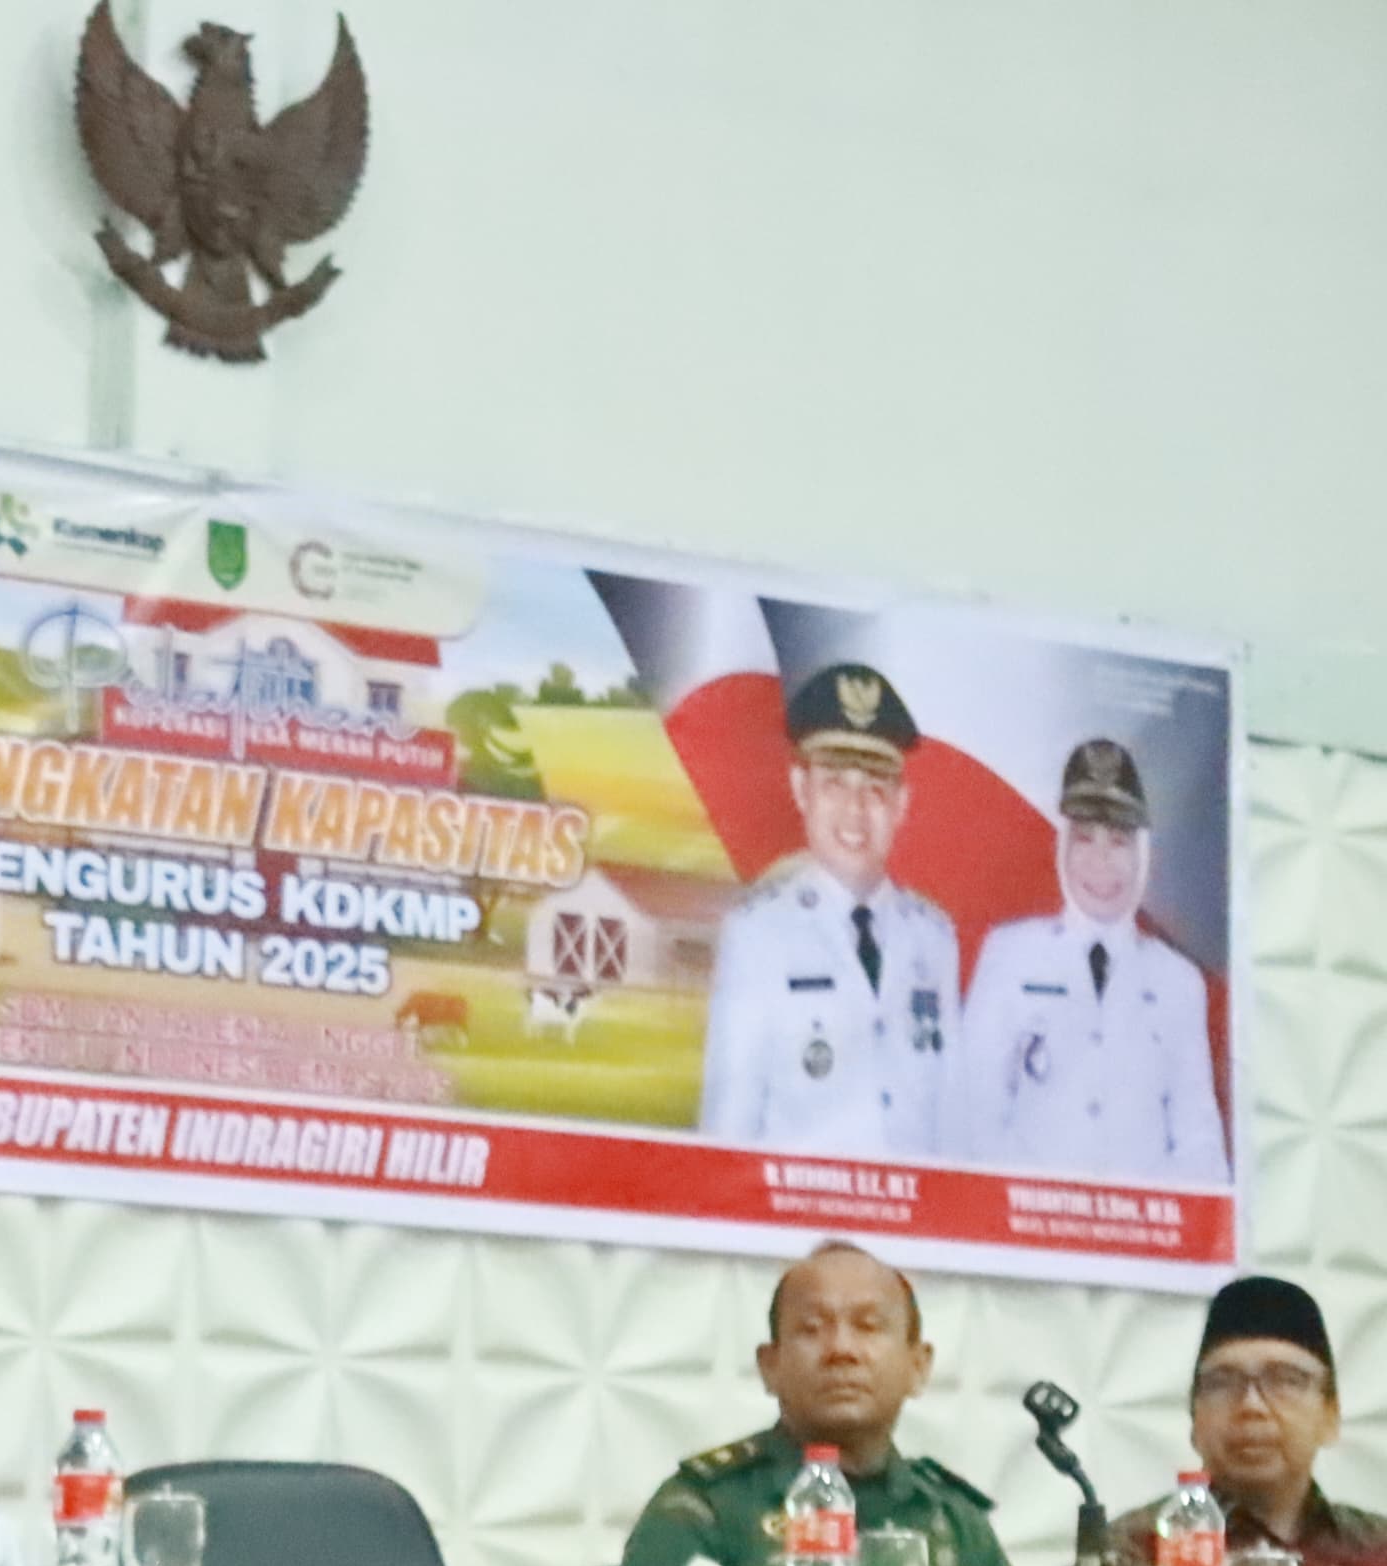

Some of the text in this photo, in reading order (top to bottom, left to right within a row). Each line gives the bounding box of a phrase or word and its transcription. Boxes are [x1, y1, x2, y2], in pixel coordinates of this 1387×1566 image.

[377, 738, 445, 771] PUTIH
[262, 769, 591, 888] KAPASITAS
[280, 875, 482, 943] KDKMP
[43, 910, 392, 996] TAHUN 2025
[171, 1106, 383, 1178] INDRAGIRI
[383, 1128, 491, 1188] HILIR
